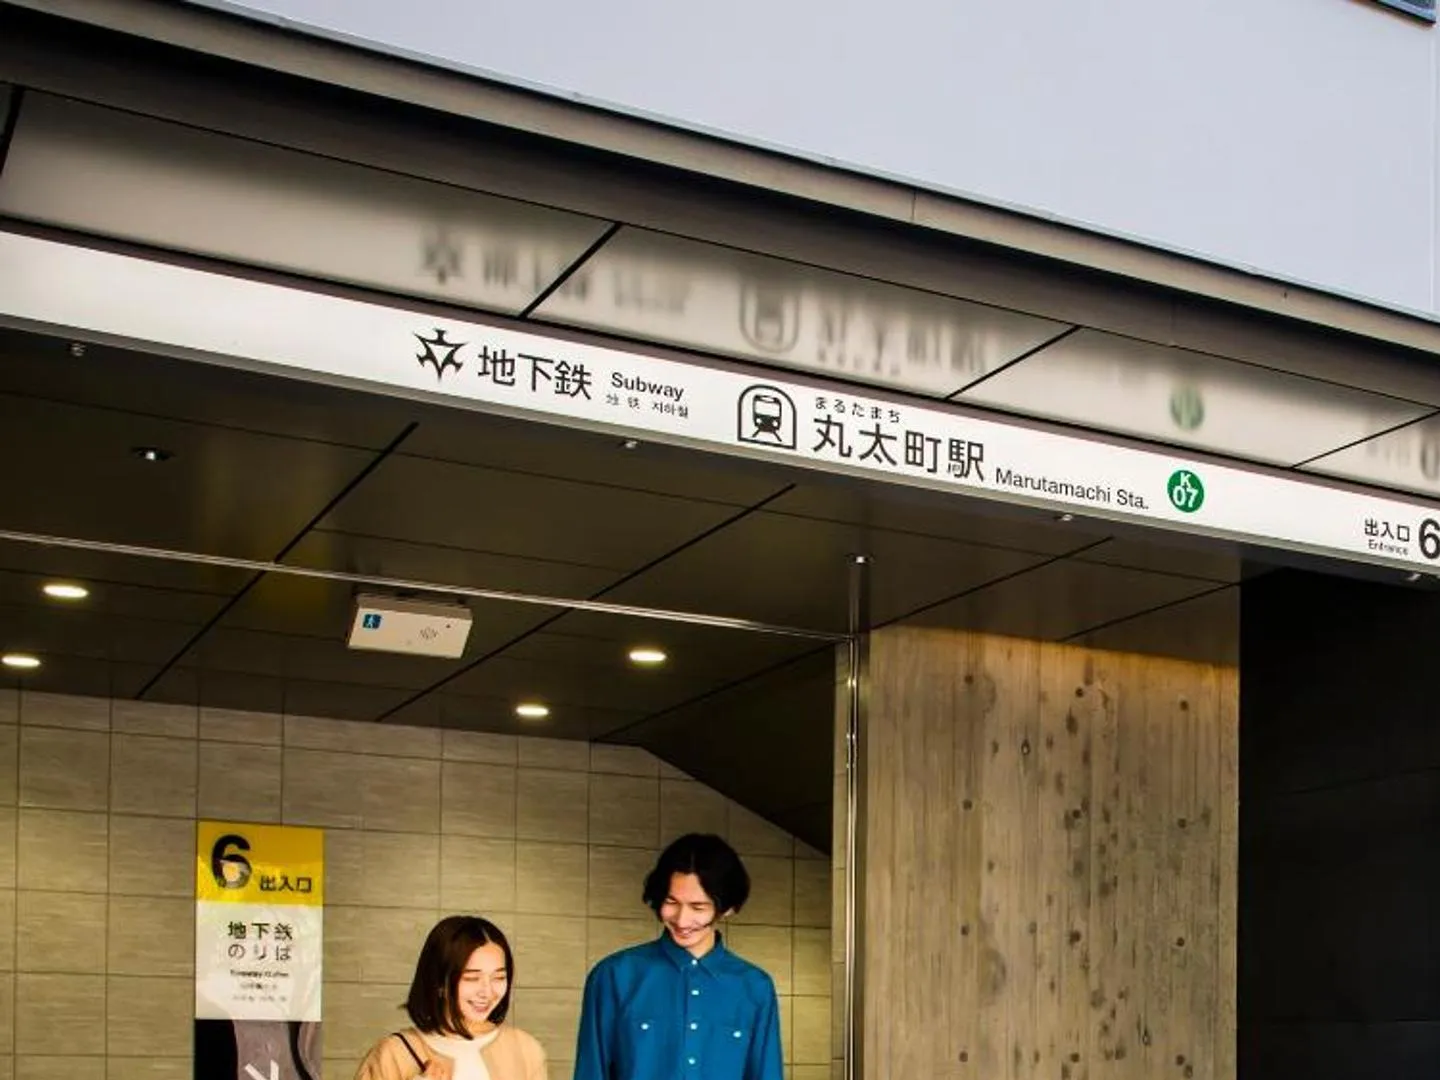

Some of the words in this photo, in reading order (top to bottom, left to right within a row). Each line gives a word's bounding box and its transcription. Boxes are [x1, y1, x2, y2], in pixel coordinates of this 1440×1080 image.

[477, 345, 592, 400] 地下鉄
[611, 372, 684, 402] Subway
[815, 396, 901, 424] まるたまち
[812, 413, 985, 482] 丸太町駅
[995, 467, 1111, 504] Marutamachi
[1116, 488, 1150, 510] Sta.
[1180, 471, 1192, 488] K
[1173, 485, 1199, 508] 07
[1364, 518, 1410, 542] 出入口
[211, 834, 253, 890] 6
[260, 875, 312, 893] 出入口
[227, 921, 293, 941] 地下鉄
